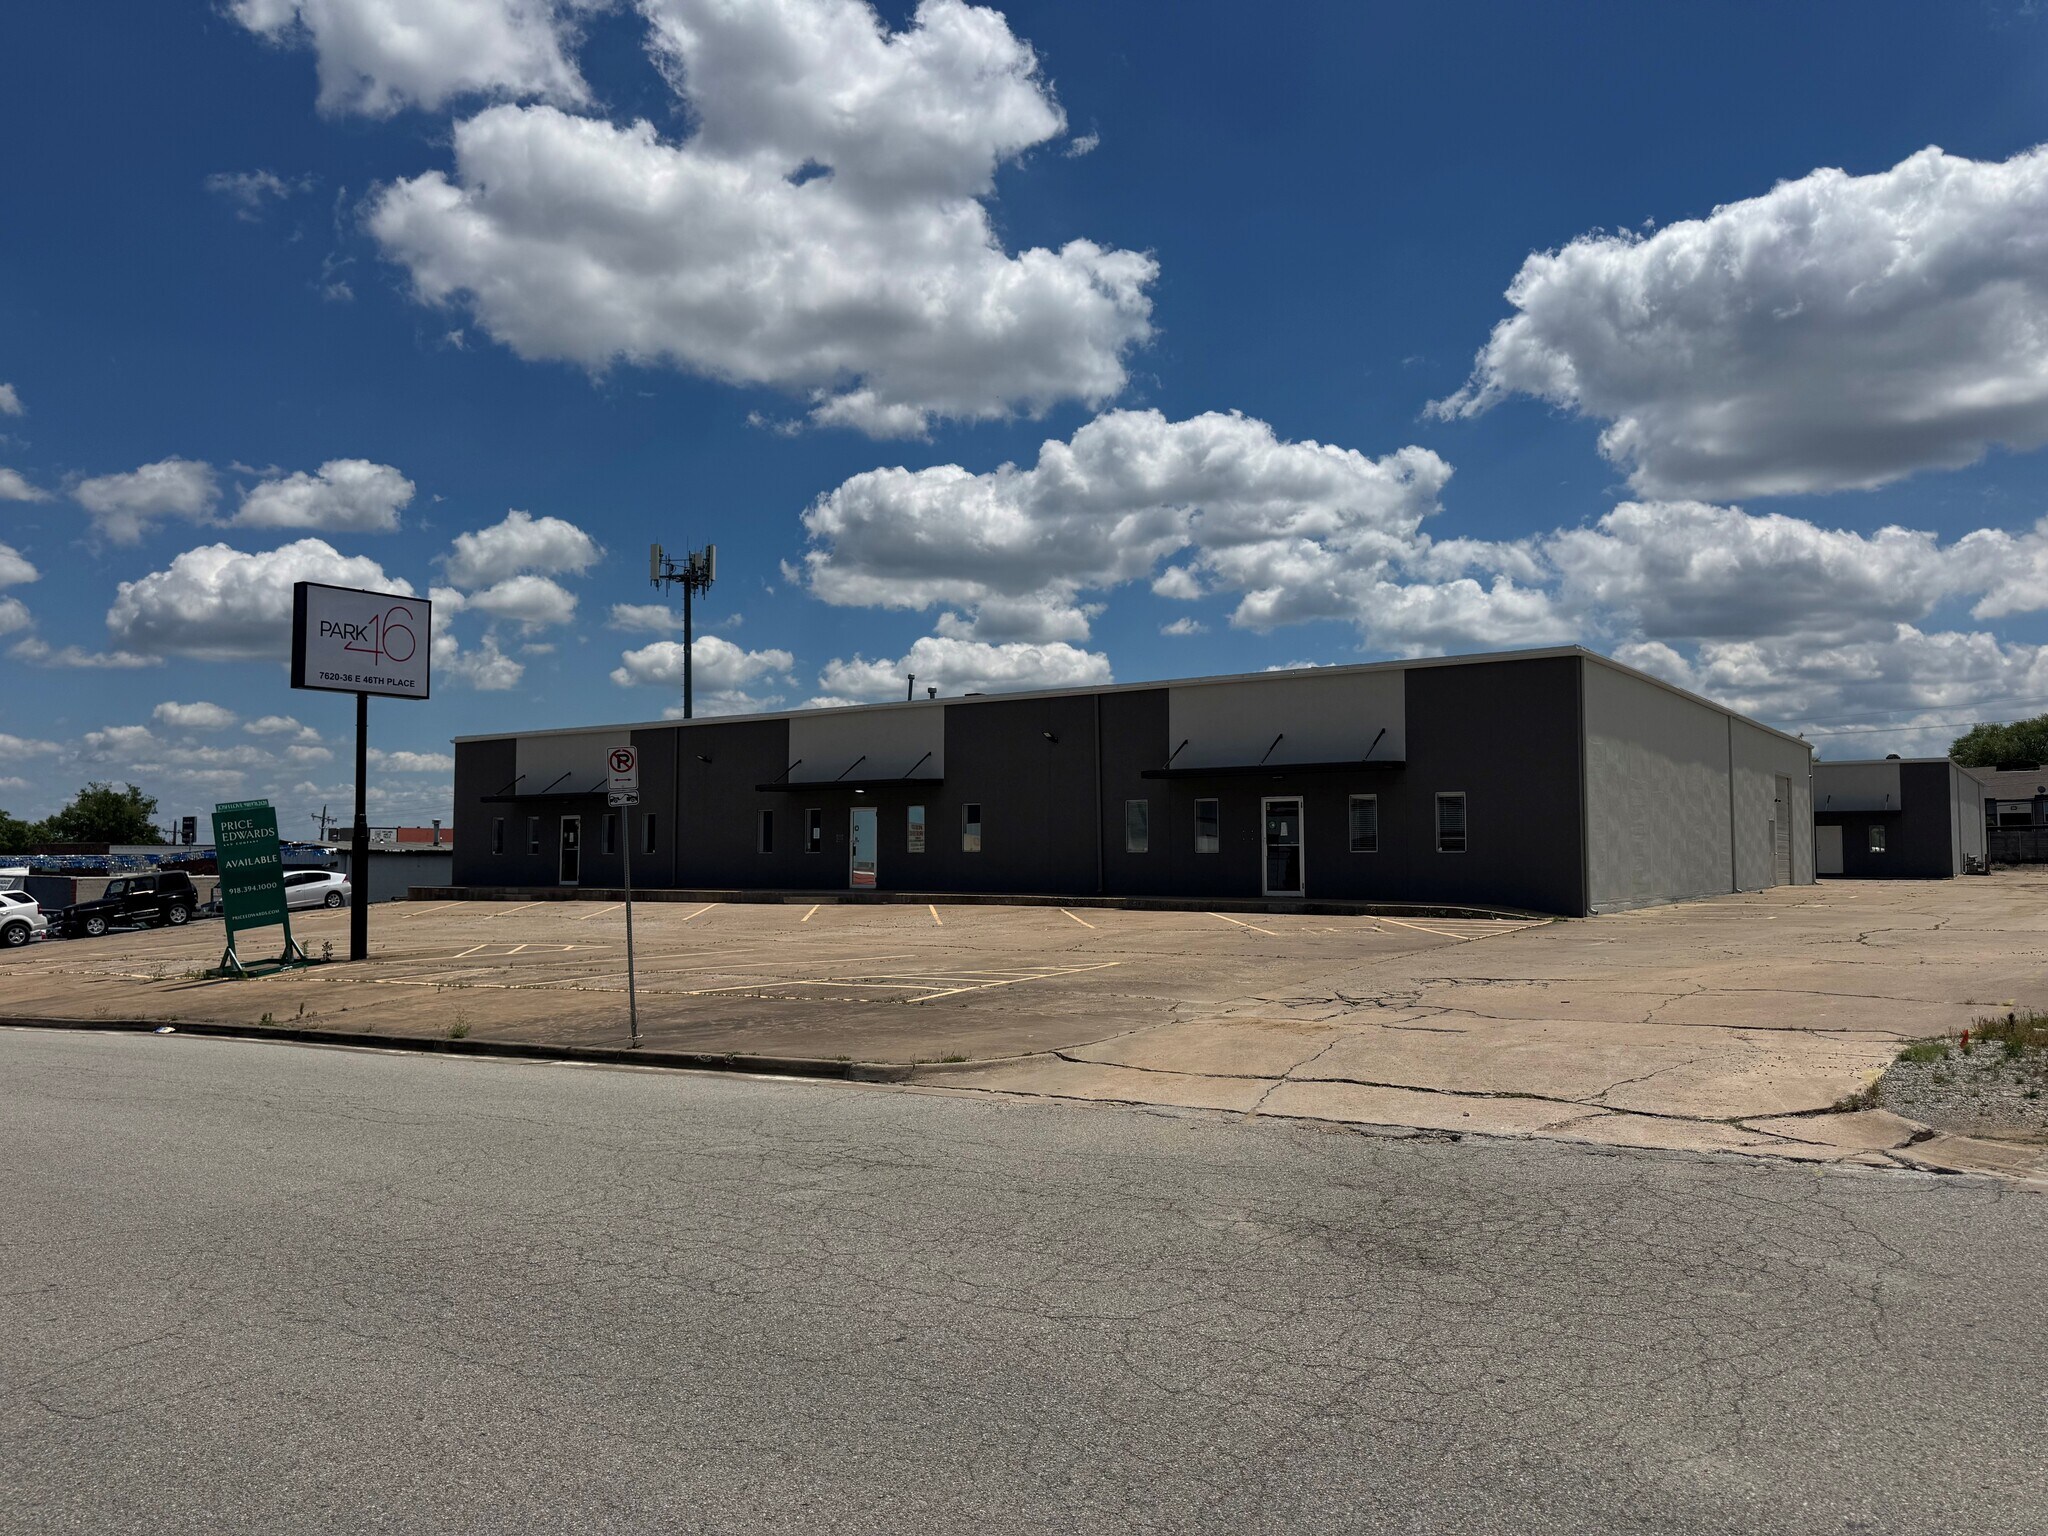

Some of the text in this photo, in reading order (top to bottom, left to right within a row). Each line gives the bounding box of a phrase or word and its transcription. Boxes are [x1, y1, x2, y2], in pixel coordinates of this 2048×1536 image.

[320, 620, 368, 642] PARK
[319, 671, 353, 682] 7620-36
[363, 676, 384, 685] 46TH
[387, 678, 415, 687] PLACE
[221, 819, 254, 831] PRICE
[222, 827, 275, 842] EDWARDS
[225, 854, 278, 869] AVAILABLE
[228, 882, 277, 895] 918.394.1000
